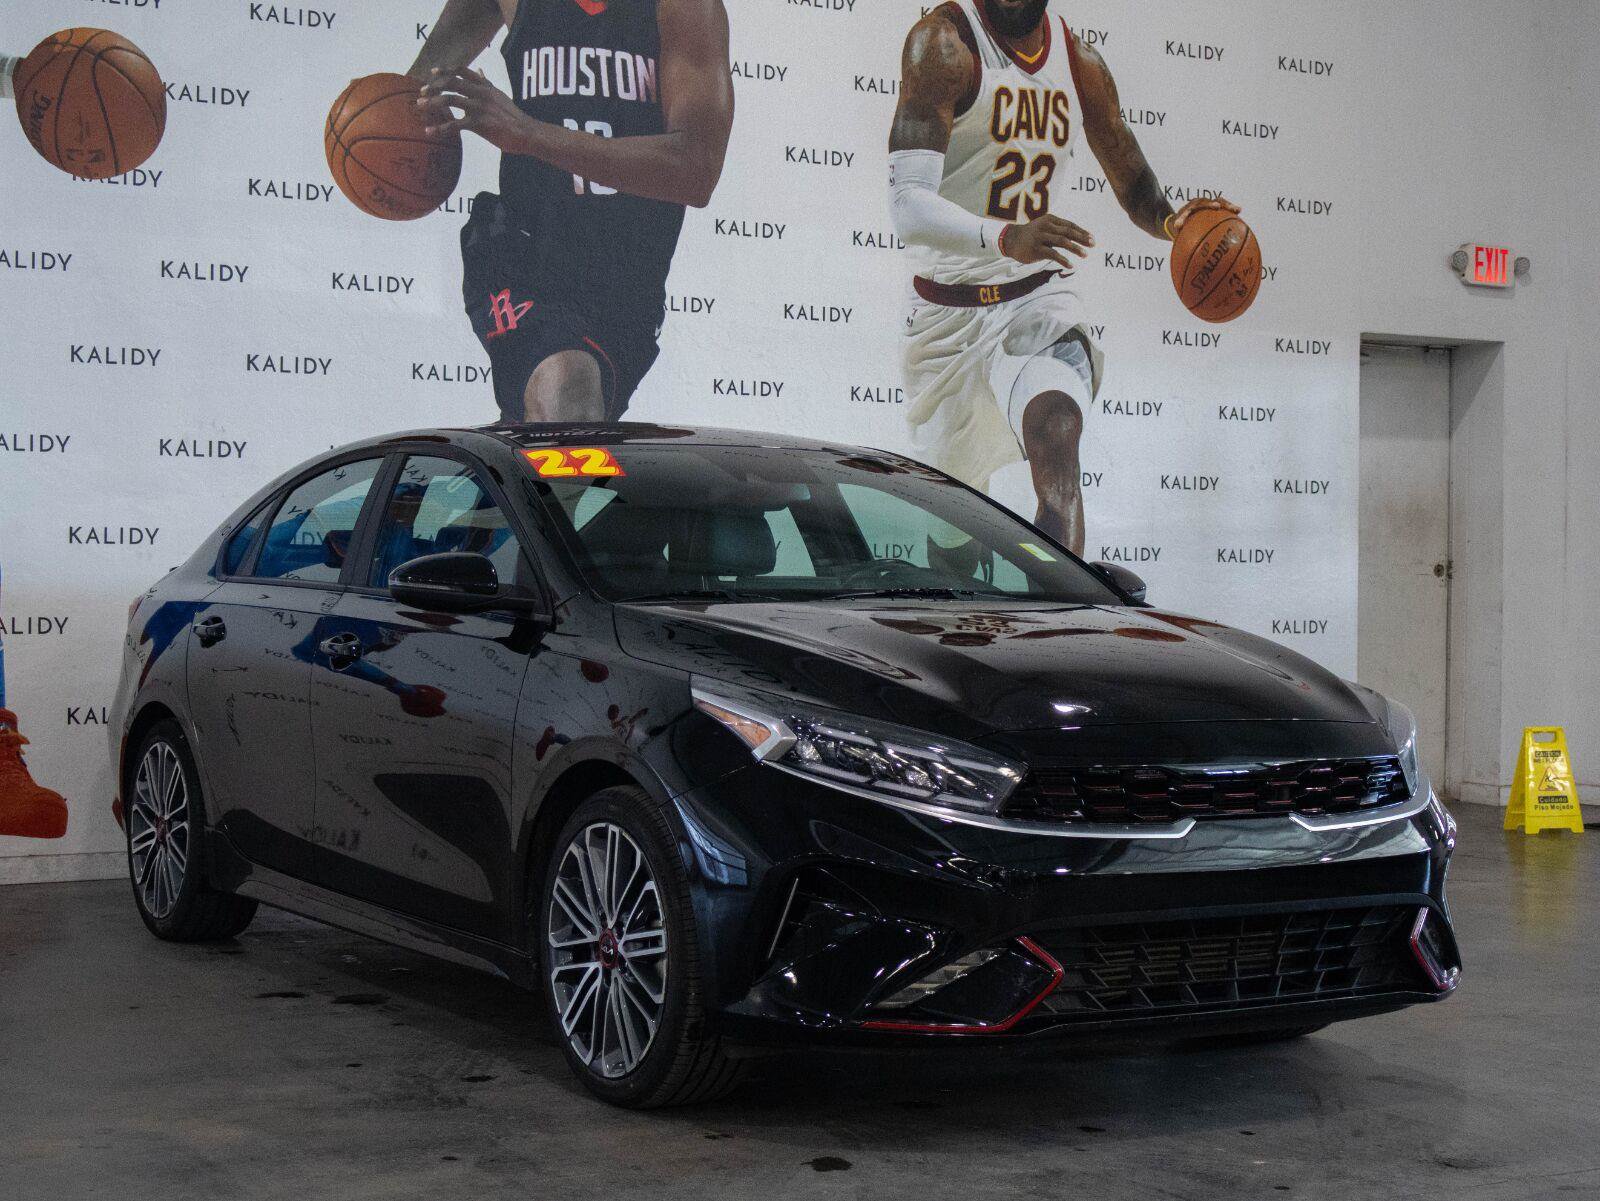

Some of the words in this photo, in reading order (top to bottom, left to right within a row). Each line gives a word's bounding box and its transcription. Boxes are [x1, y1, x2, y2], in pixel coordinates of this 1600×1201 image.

[250, 3, 336, 29] KALIDY
[1166, 41, 1225, 61] KALIDY
[522, 46, 656, 102] HOUSTON
[732, 62, 788, 82] ALIDY
[1279, 56, 1334, 76] KALIDY
[163, 82, 250, 107] KALIDY
[854, 75, 902, 95] KALI
[990, 84, 1070, 148] CAVS
[1120, 108, 1167, 127] ALIDY
[1222, 120, 1279, 140] KALIDY
[786, 146, 855, 168] KALIDY
[249, 178, 335, 202] KALIDY
[985, 149, 1056, 224] 23
[1277, 197, 1332, 216] KALIDY
[716, 219, 786, 240] KALIDY
[0, 250, 72, 272] ALIDY
[1105, 253, 1165, 272] KALIDY
[1474, 246, 1509, 285] EXIT
[161, 260, 249, 283] KALIDY
[331, 272, 414, 295] KALIDY
[979, 285, 1001, 304] CLE
[667, 297, 716, 314] LIDY
[784, 304, 853, 323] KALIDY
[1163, 330, 1221, 348] KALIDY
[1276, 338, 1331, 355] KALIDY
[70, 345, 161, 367] KALIDY
[246, 354, 332, 376] KALIDY
[412, 362, 491, 384] KALIDY
[714, 378, 784, 398] KALIDY
[851, 386, 904, 404] KALID
[1103, 400, 1163, 417] KALIDY
[1219, 406, 1276, 422] KALIDY
[0, 434, 71, 453] ALIDY
[159, 438, 247, 459] KALIDY
[526, 449, 620, 475] 22
[1161, 475, 1219, 491] KALIDY
[1274, 479, 1330, 494] KALIDY
[68, 526, 160, 545] KALIDY
[1101, 547, 1161, 562] KALIDY
[1217, 549, 1274, 564] KALIDY
[0, 616, 69, 635] ALIDY
[1273, 620, 1328, 635] KALIDY
[67, 708, 109, 725] KAL
